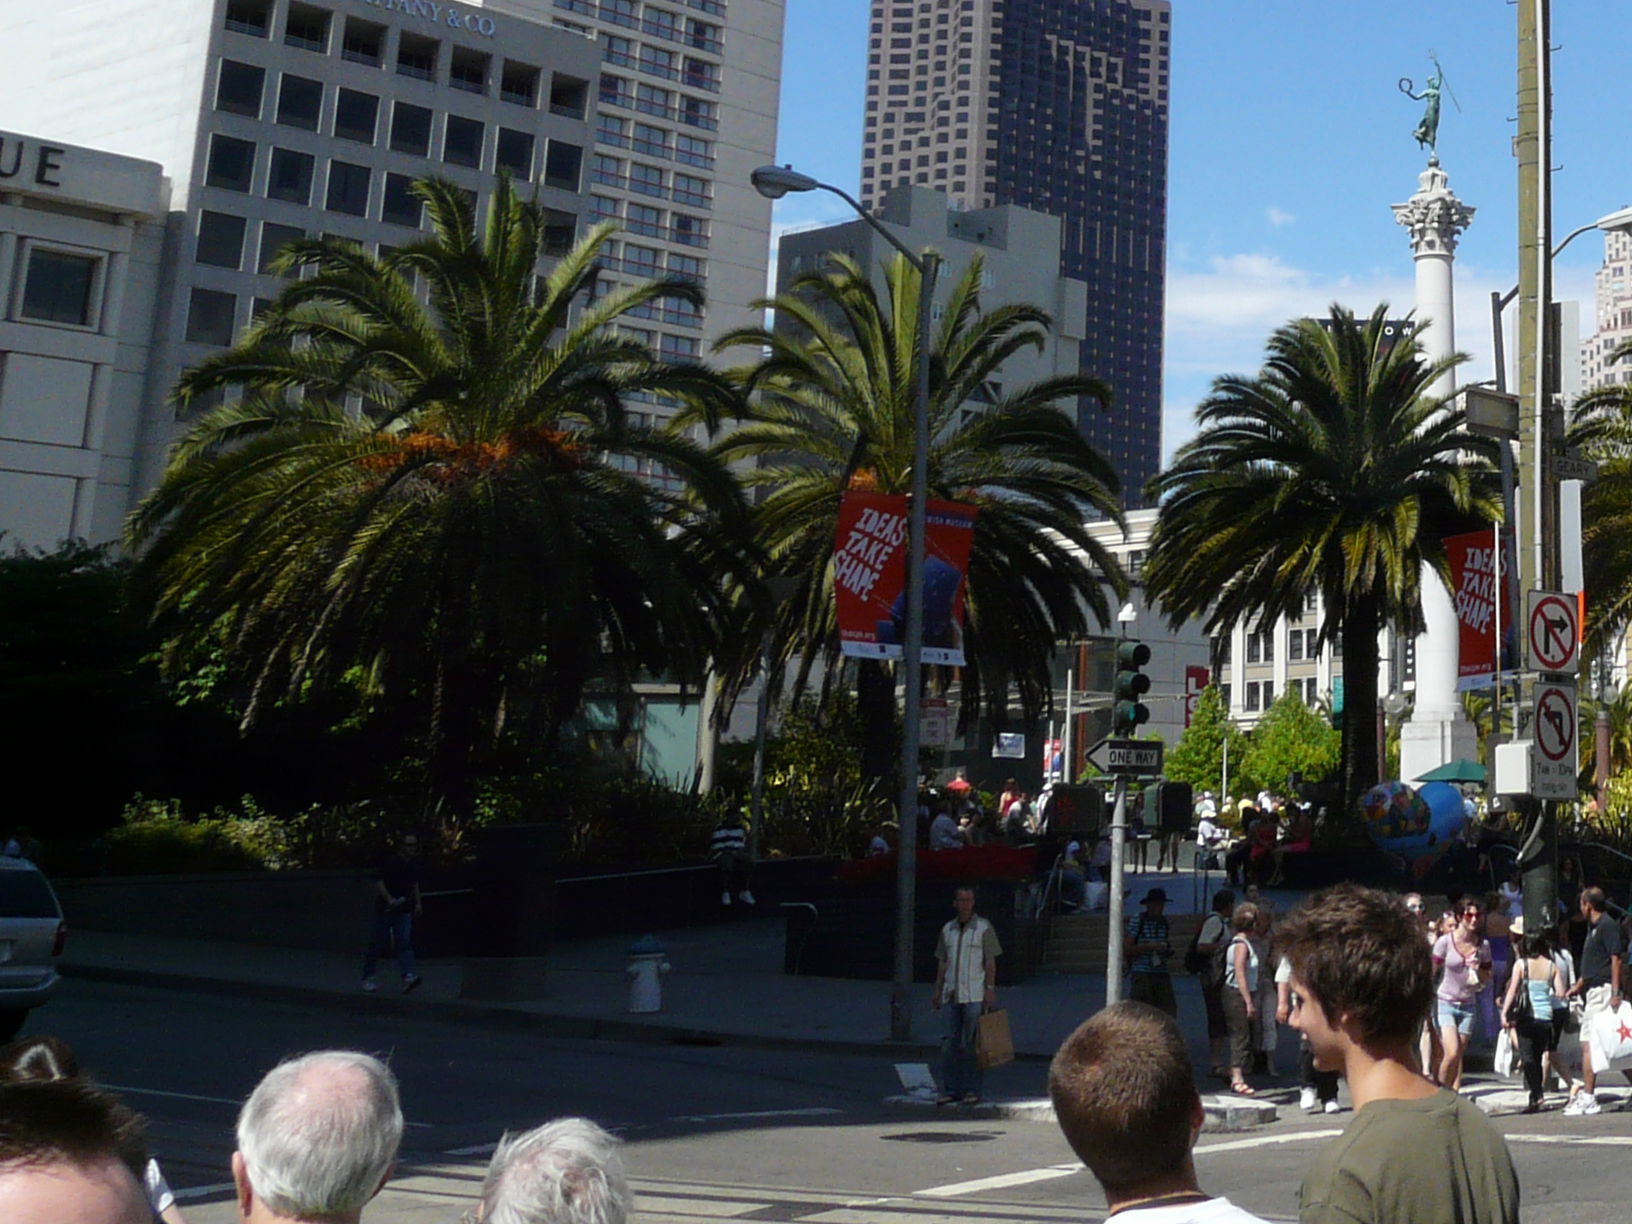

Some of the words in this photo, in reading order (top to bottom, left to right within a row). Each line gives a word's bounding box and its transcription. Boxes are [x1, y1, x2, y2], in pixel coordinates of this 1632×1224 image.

[447, 8, 460, 28] &
[1557, 459, 1590, 474] GEARY
[854, 508, 907, 546] IDEAS
[844, 531, 893, 571] TAKE
[835, 549, 880, 602] SHAPE
[1456, 590, 1494, 635] SHAPE
[1109, 751, 1132, 763] ONE
[1136, 751, 1155, 763] WAY
